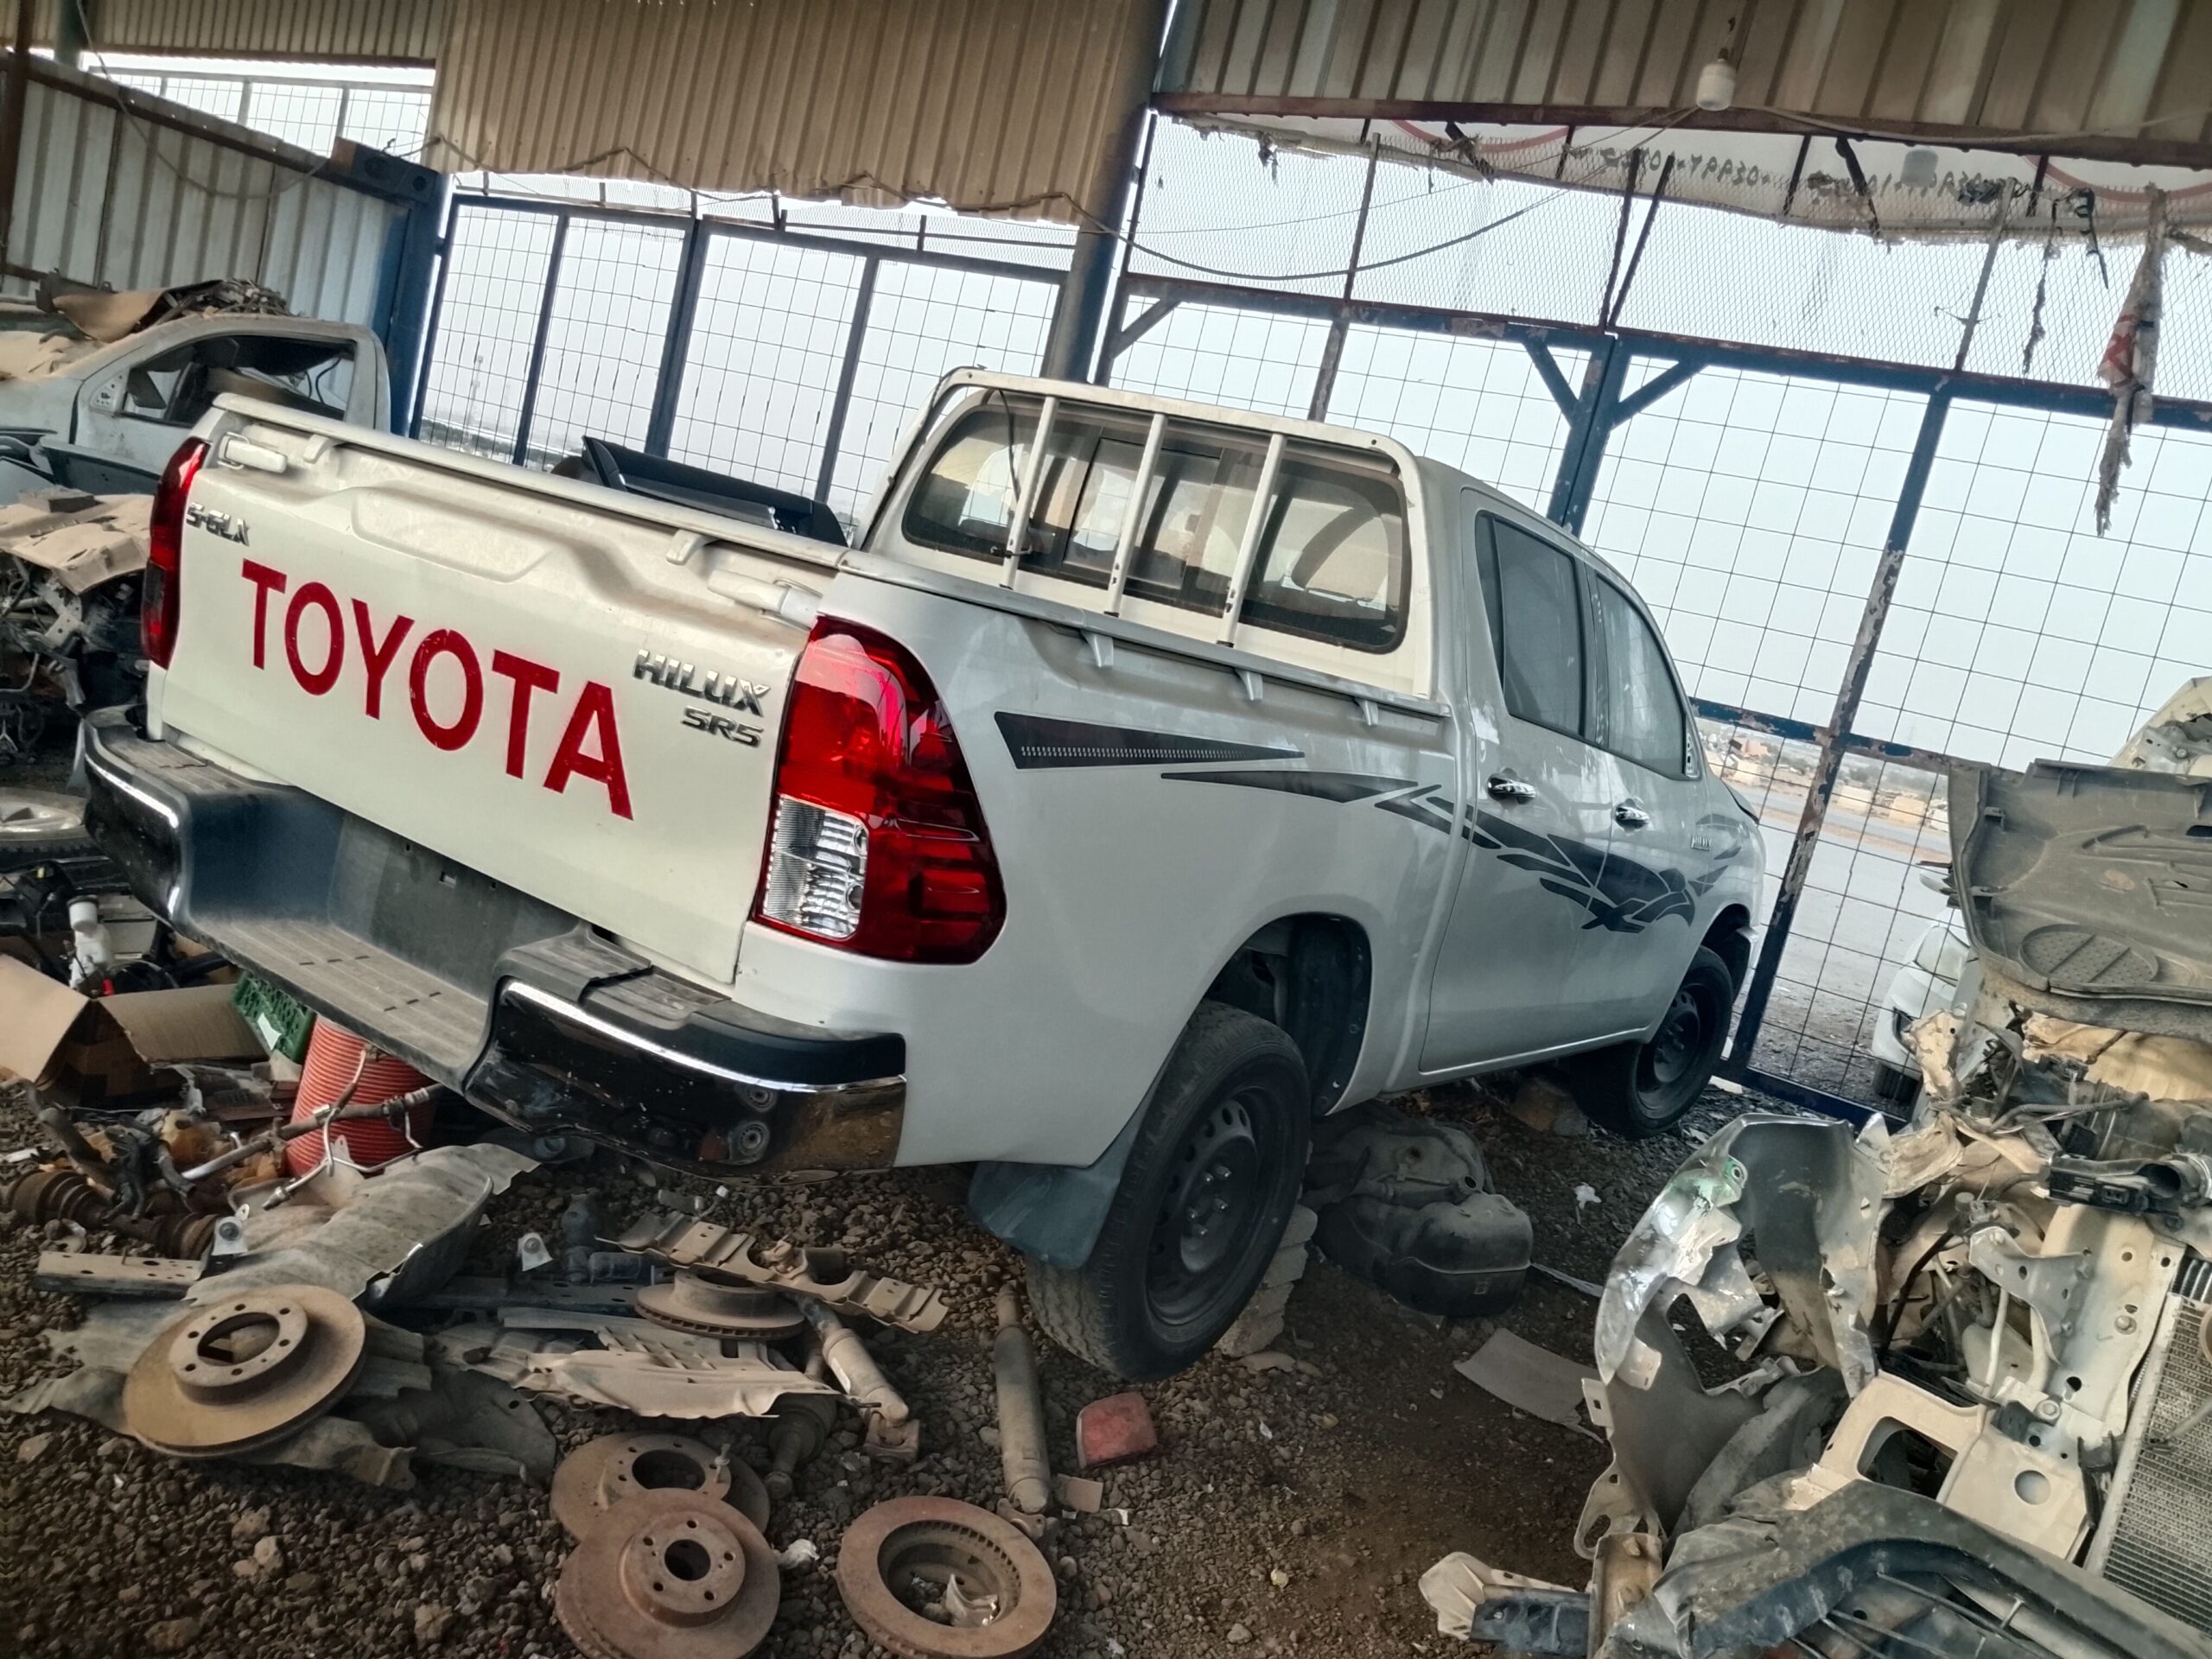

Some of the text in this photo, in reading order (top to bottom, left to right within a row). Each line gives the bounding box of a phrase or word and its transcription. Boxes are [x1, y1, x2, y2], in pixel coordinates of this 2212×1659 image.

[241, 557, 634, 821] TOYOTA
[632, 648, 772, 717] HILUX
[680, 705, 765, 748] SR5
